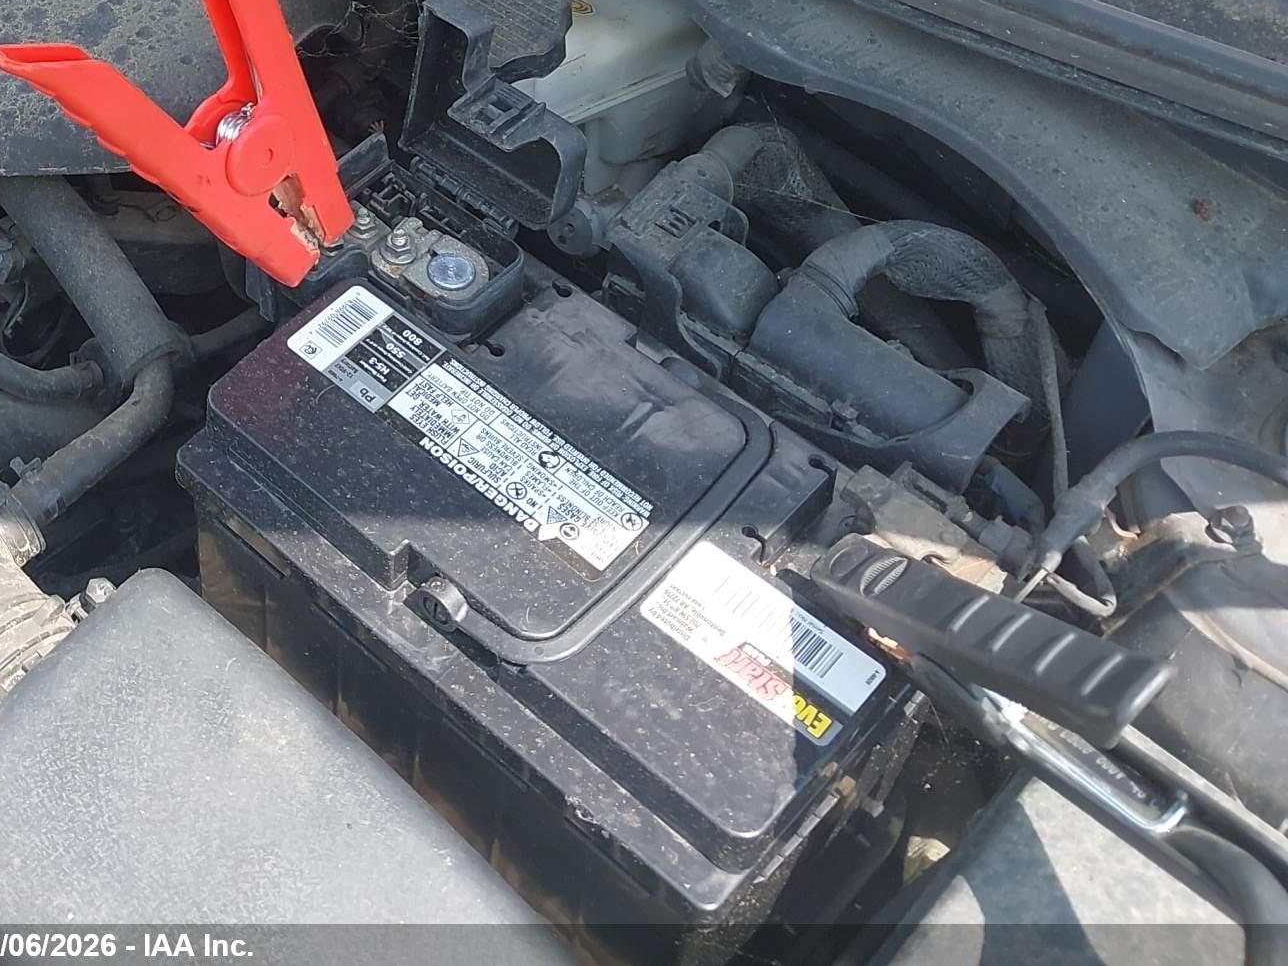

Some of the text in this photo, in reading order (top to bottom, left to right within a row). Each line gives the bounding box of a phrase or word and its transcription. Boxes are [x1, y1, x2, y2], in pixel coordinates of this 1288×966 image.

[400, 327, 424, 346] 800
[384, 341, 407, 359] 550
[356, 386, 377, 403] Pb
[404, 387, 421, 400] GET
[410, 382, 442, 407] MEDICAL
[416, 377, 454, 407] HELP FAST.
[450, 389, 469, 404] OPEN
[465, 401, 481, 414] NOT
[470, 395, 486, 409] NOT
[483, 405, 496, 416] DO
[408, 403, 455, 440] IMMEDIATELY
[415, 398, 461, 434] WITH WATER.
[479, 411, 490, 421] DO
[407, 412, 449, 445] FLUSH EYES
[474, 432, 519, 467] BLINDNESS OR
[499, 442, 524, 462] SEVERE
[508, 433, 538, 456] READ ALL
[479, 445, 513, 472] CAN CAUSE
[465, 456, 502, 484] SULFURIC
[487, 461, 507, 478] ACID
[417, 435, 541, 533] DANGER/POISON
[592, 487, 605, 498] OF
[599, 478, 610, 488] OF
[525, 496, 538, 508] NO
[567, 478, 619, 518] KEEP OUT OF THE
[603, 494, 625, 513] REACH
[555, 502, 582, 523] GASES
[714, 643, 835, 739] EvStart
